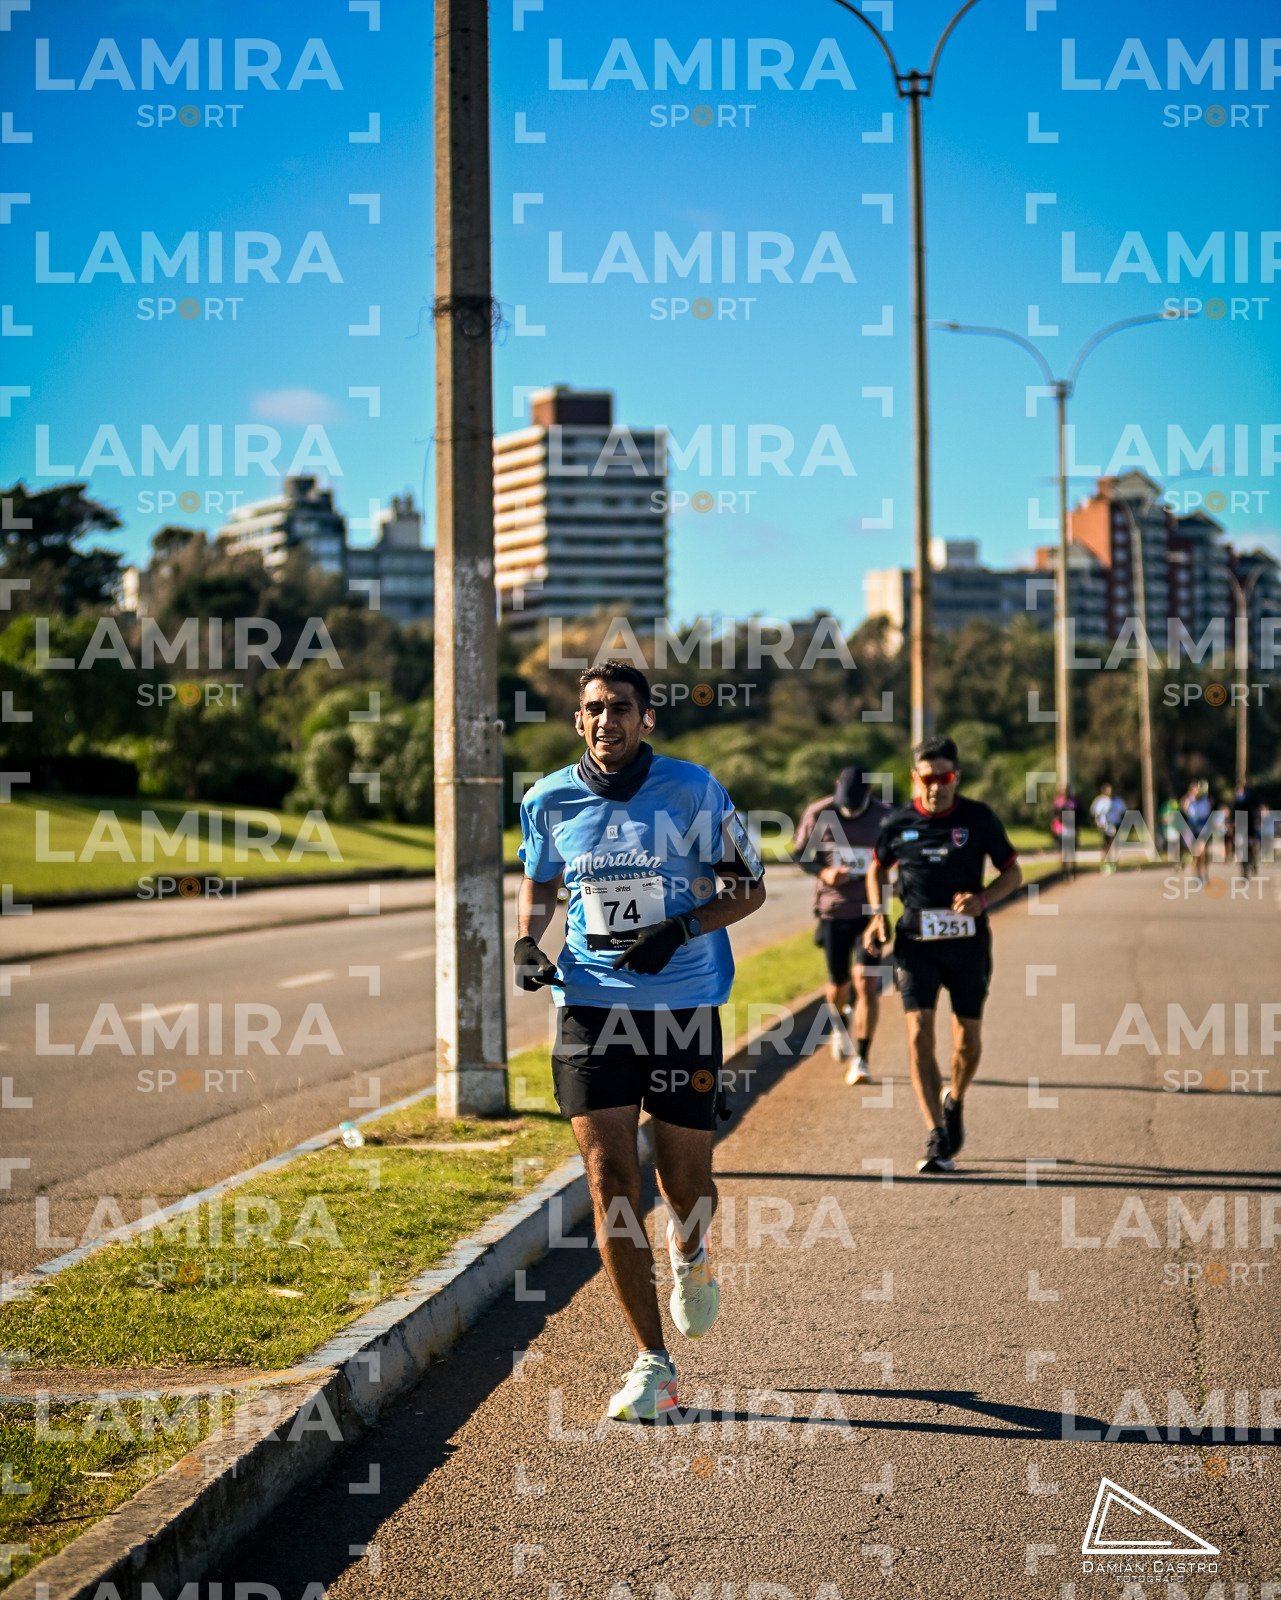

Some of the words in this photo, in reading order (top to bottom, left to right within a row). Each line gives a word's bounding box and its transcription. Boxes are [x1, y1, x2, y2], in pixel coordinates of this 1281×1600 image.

[571, 848, 662, 876] Maratón
[586, 870, 656, 882] ONTEVIDEO
[603, 899, 641, 926] 74
[928, 920, 969, 936] 1251
